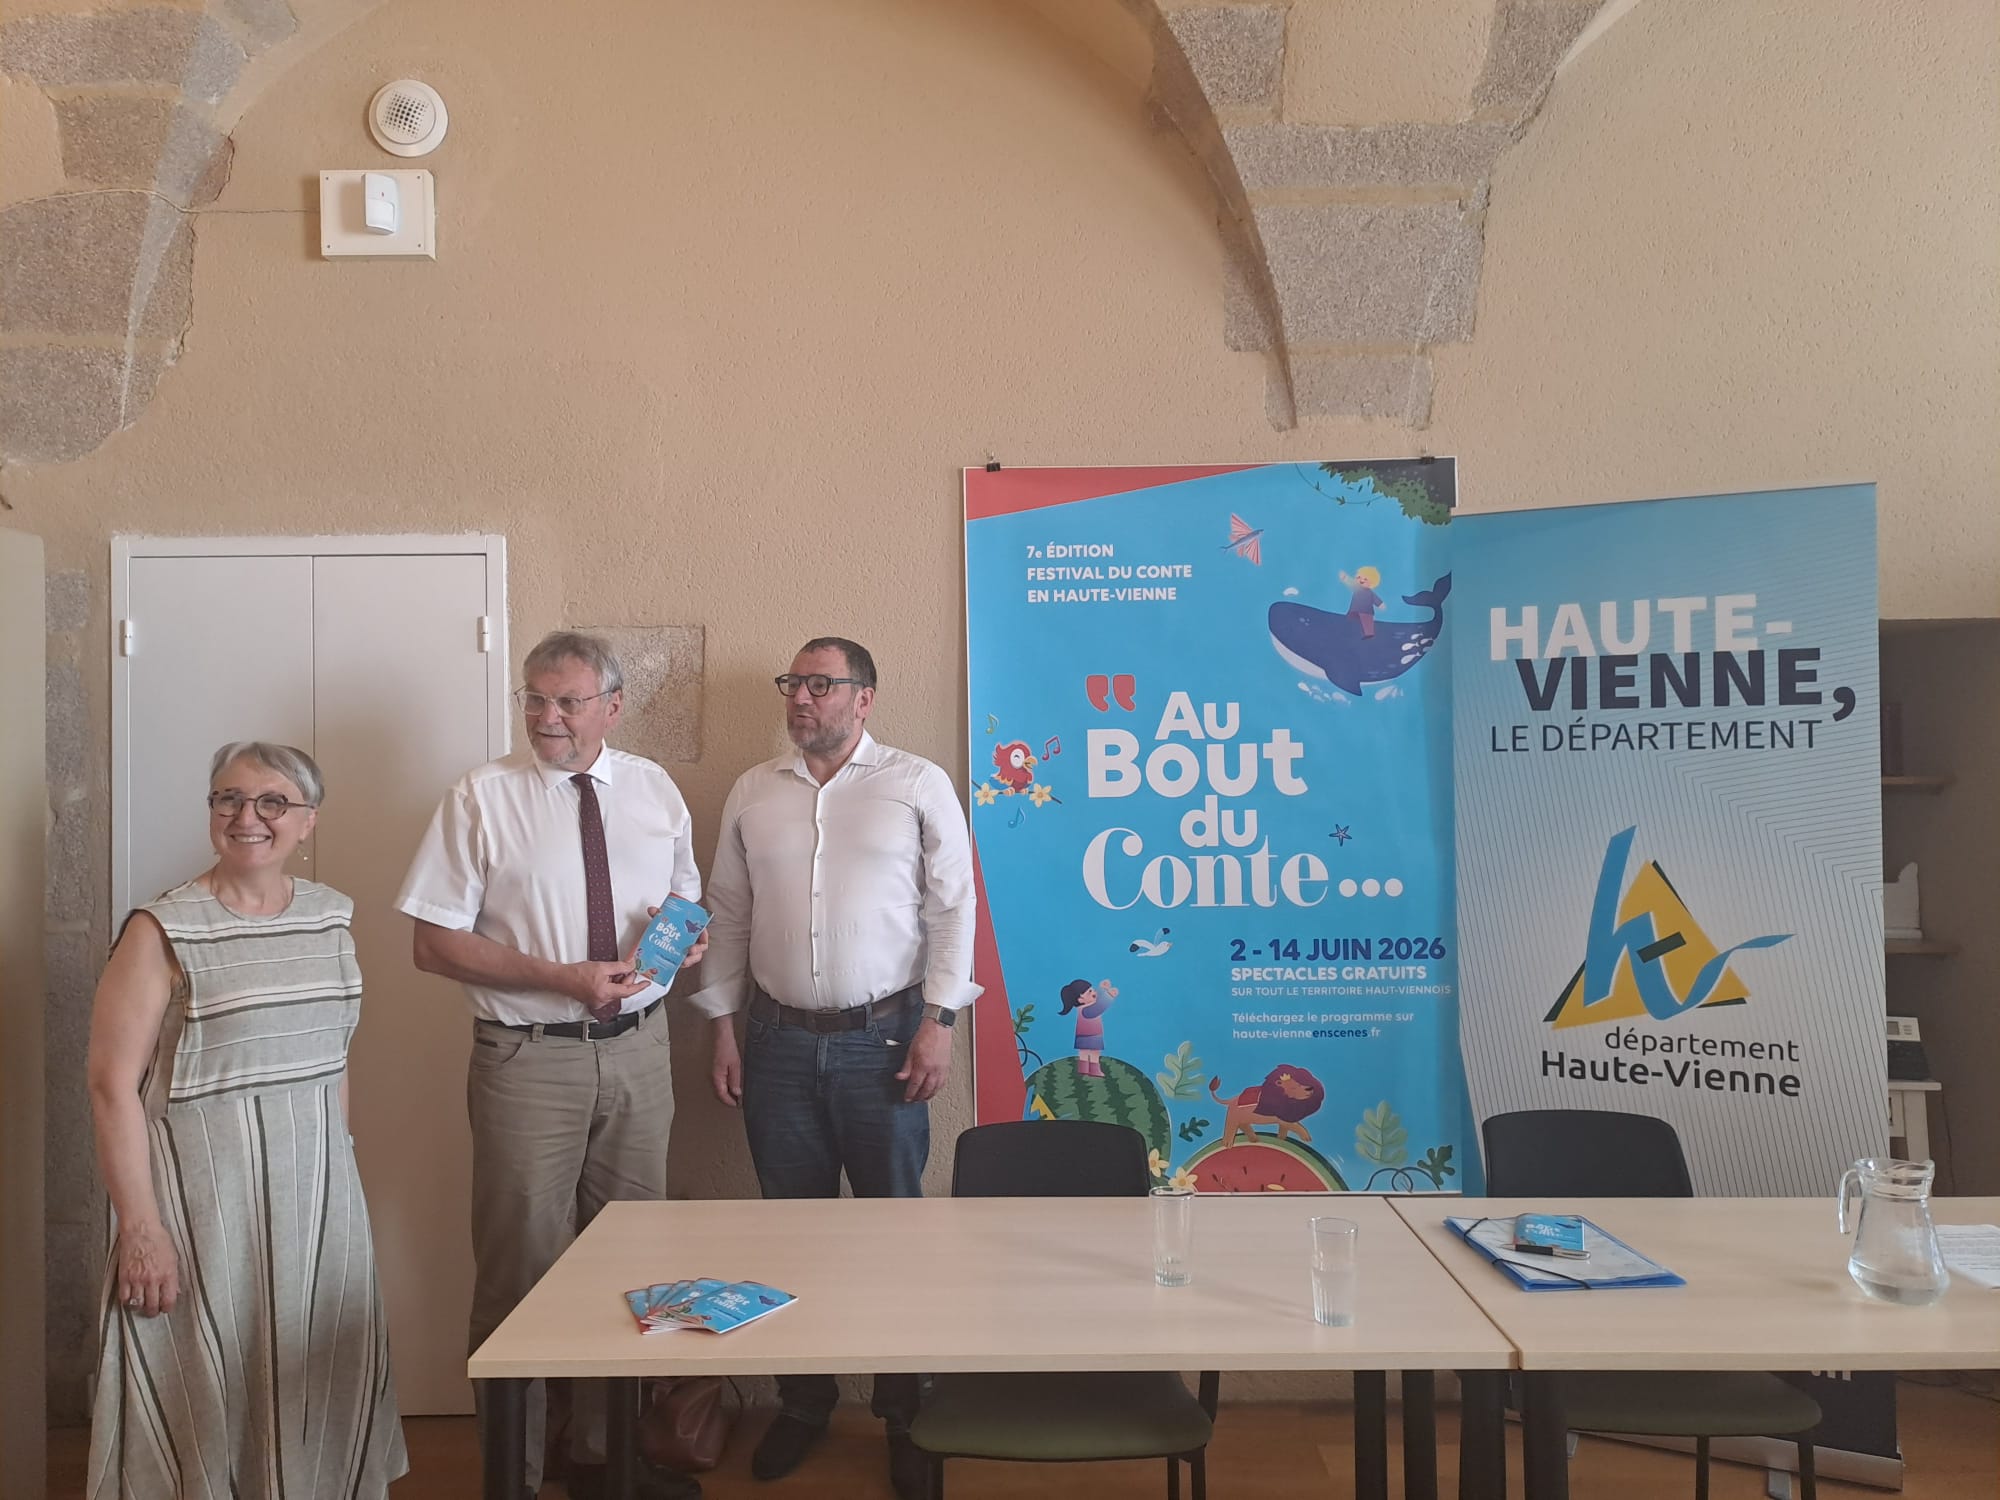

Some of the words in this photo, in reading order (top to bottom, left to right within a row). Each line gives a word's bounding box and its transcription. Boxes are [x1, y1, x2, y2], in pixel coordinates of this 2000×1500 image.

[1046, 541, 1114, 558] ÉDITION
[1027, 566, 1104, 581] FESTIVAL
[1108, 566, 1132, 579] DU
[1136, 564, 1192, 578] CONTE
[1027, 589, 1049, 603] EN
[1053, 587, 1177, 602] HAUTE-VIENNE
[1489, 593, 1793, 661] HAUTE-
[1515, 647, 1856, 722] VIENNE,
[1154, 691, 1240, 740] Au
[1491, 724, 1530, 752] LE
[1542, 716, 1823, 752] DÉPARTEMENT
[1087, 728, 1308, 798] Bout
[1180, 795, 1258, 848] du
[1230, 938, 1246, 961] 2
[1268, 938, 1300, 961] 14
[1306, 938, 1371, 961] JUIN
[1378, 937, 1446, 960] 2026
[1231, 967, 1338, 981] SPECTACLES
[1341, 966, 1427, 980] GRATUITS
[1231, 987, 1253, 996] SUR
[1255, 987, 1284, 996] TOUT
[1286, 987, 1299, 996] LE
[1302, 986, 1363, 996] TERRITOIRE
[1365, 985, 1451, 995] HAUT-VIENNOIS
[1232, 1013, 1304, 1025] Téléchargez
[1307, 1013, 1318, 1022] le
[1321, 1013, 1392, 1025] programme
[1395, 1013, 1413, 1022] sur
[1604, 1026, 1800, 1062] département
[1541, 1050, 1801, 1097] Haute-Vienne
